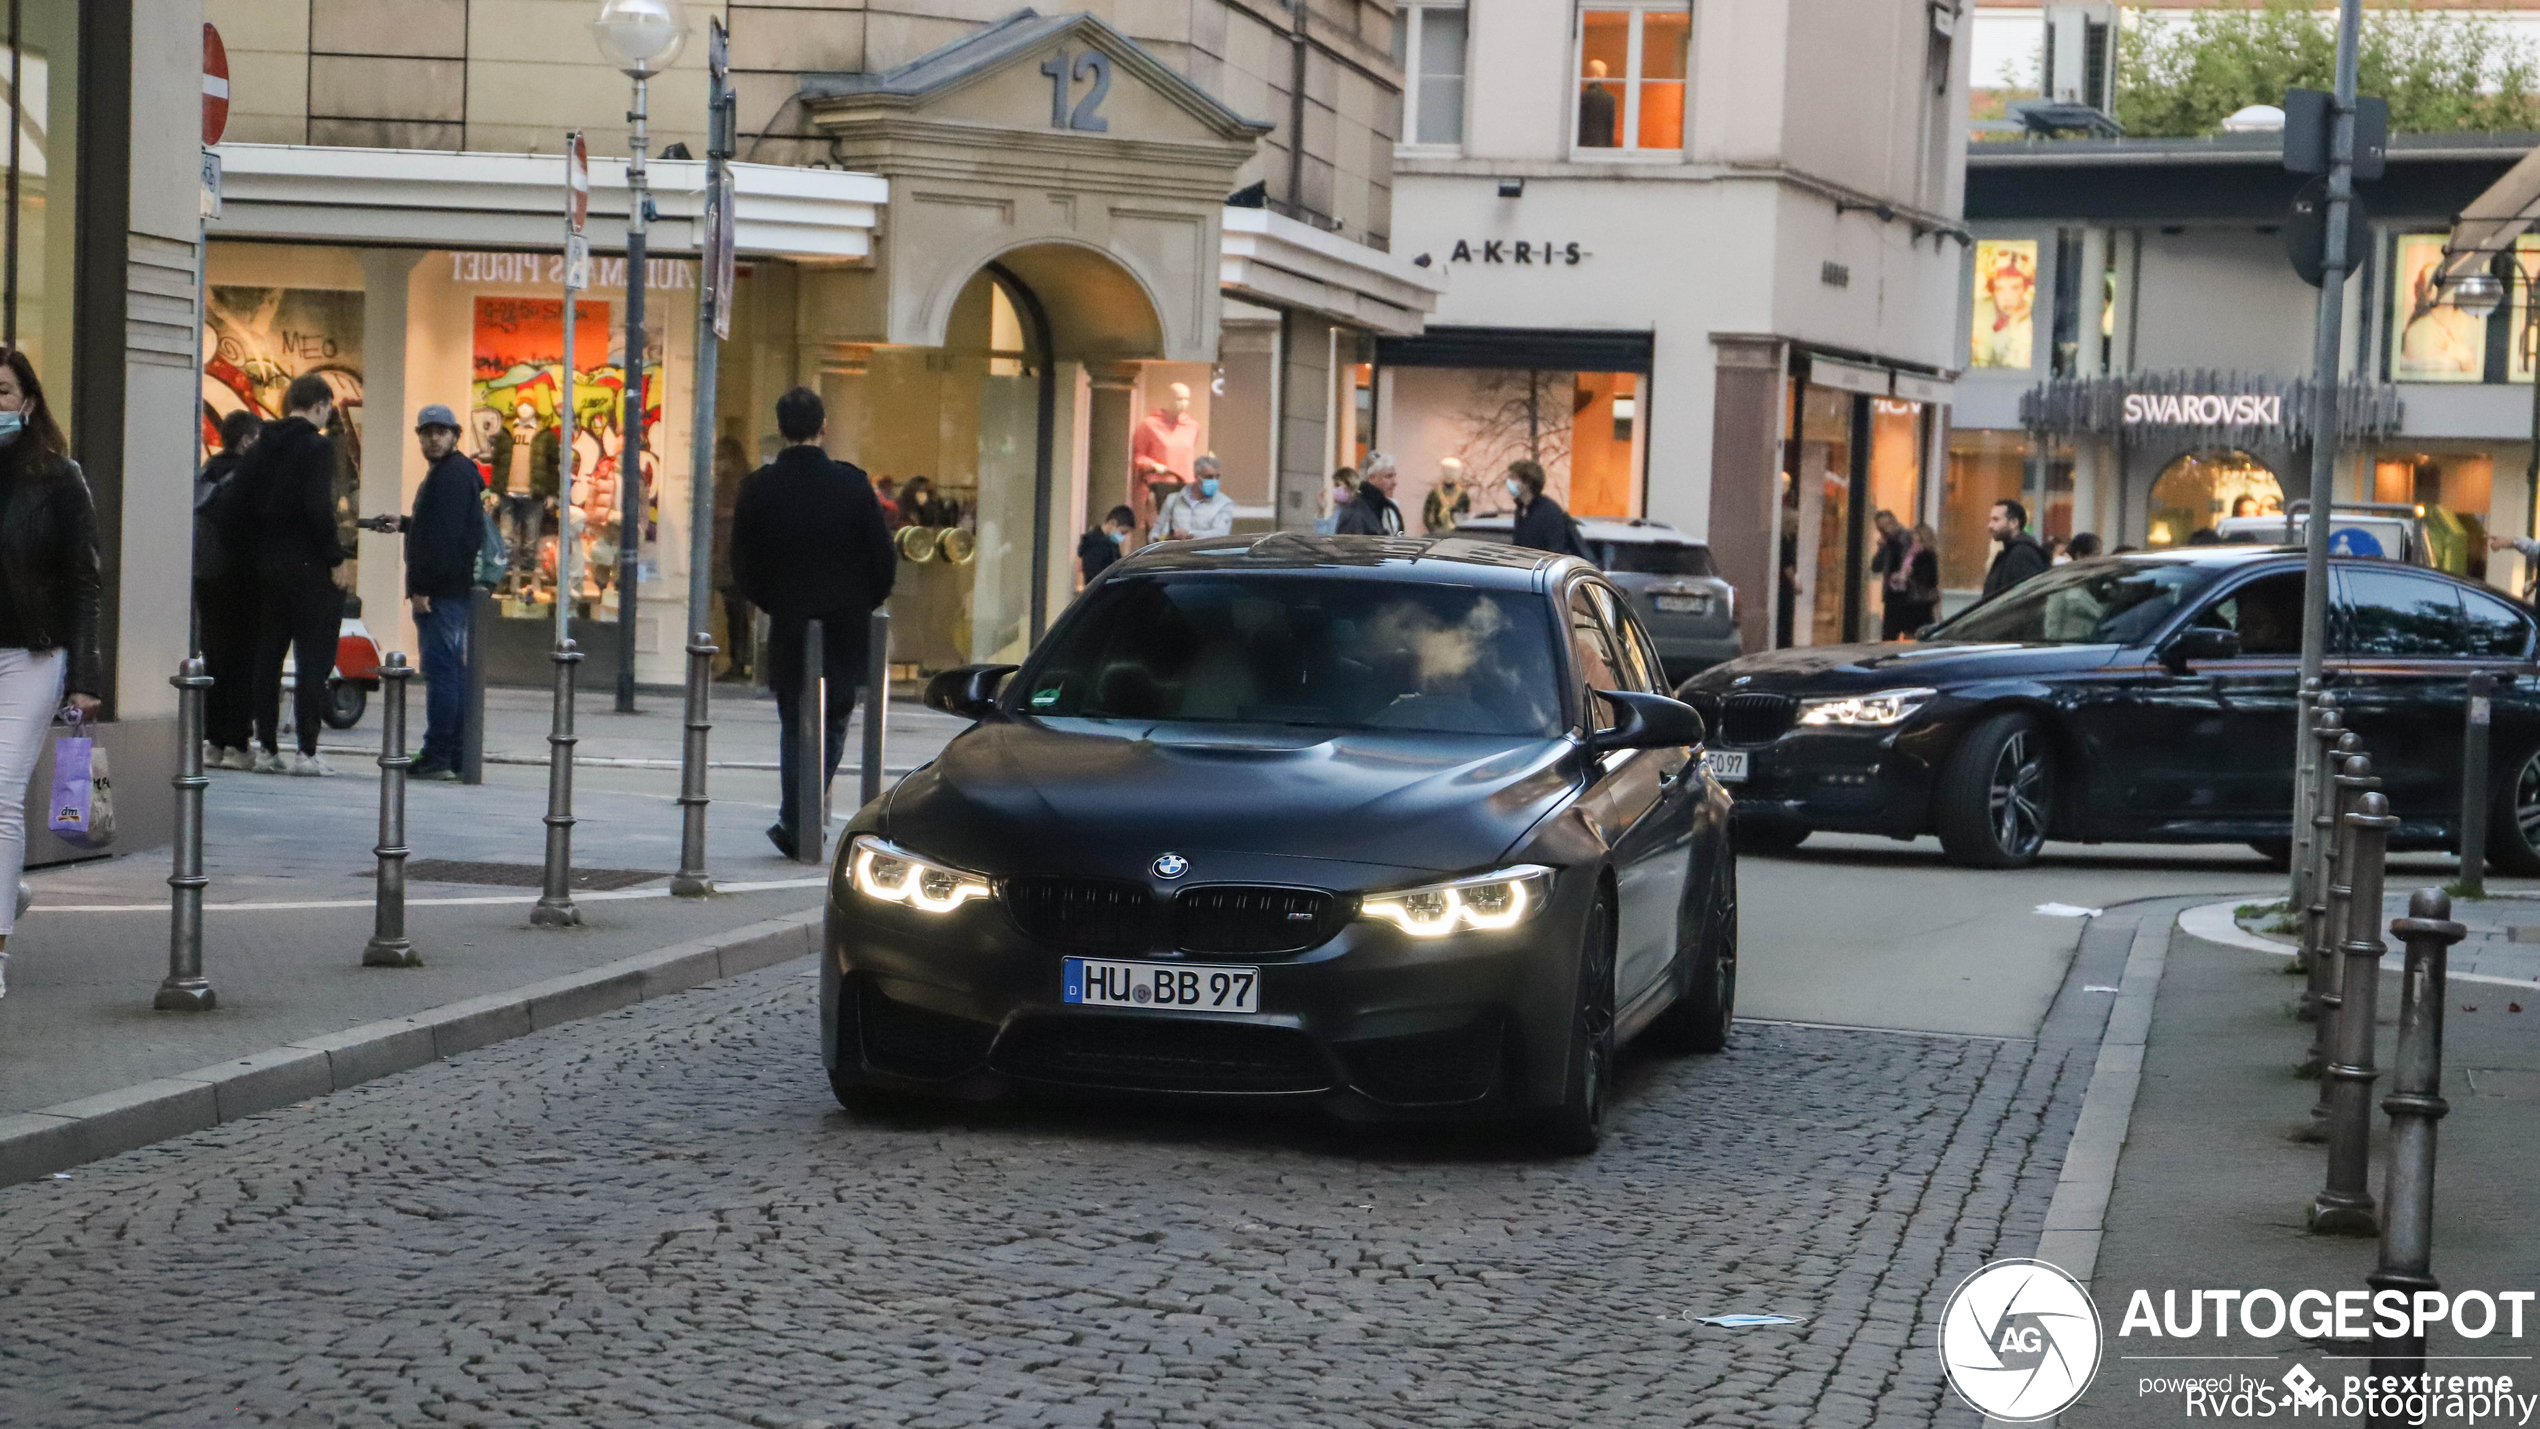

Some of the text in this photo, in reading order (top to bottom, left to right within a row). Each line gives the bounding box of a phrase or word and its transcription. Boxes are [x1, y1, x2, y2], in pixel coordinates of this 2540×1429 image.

[1041, 49, 1110, 132] 12
[2123, 394, 2281, 424] SWAROVSKI
[1727, 755, 1743, 773] 97
[61, 806, 78, 816] dm
[1069, 965, 1255, 1008] D HU BB 97
